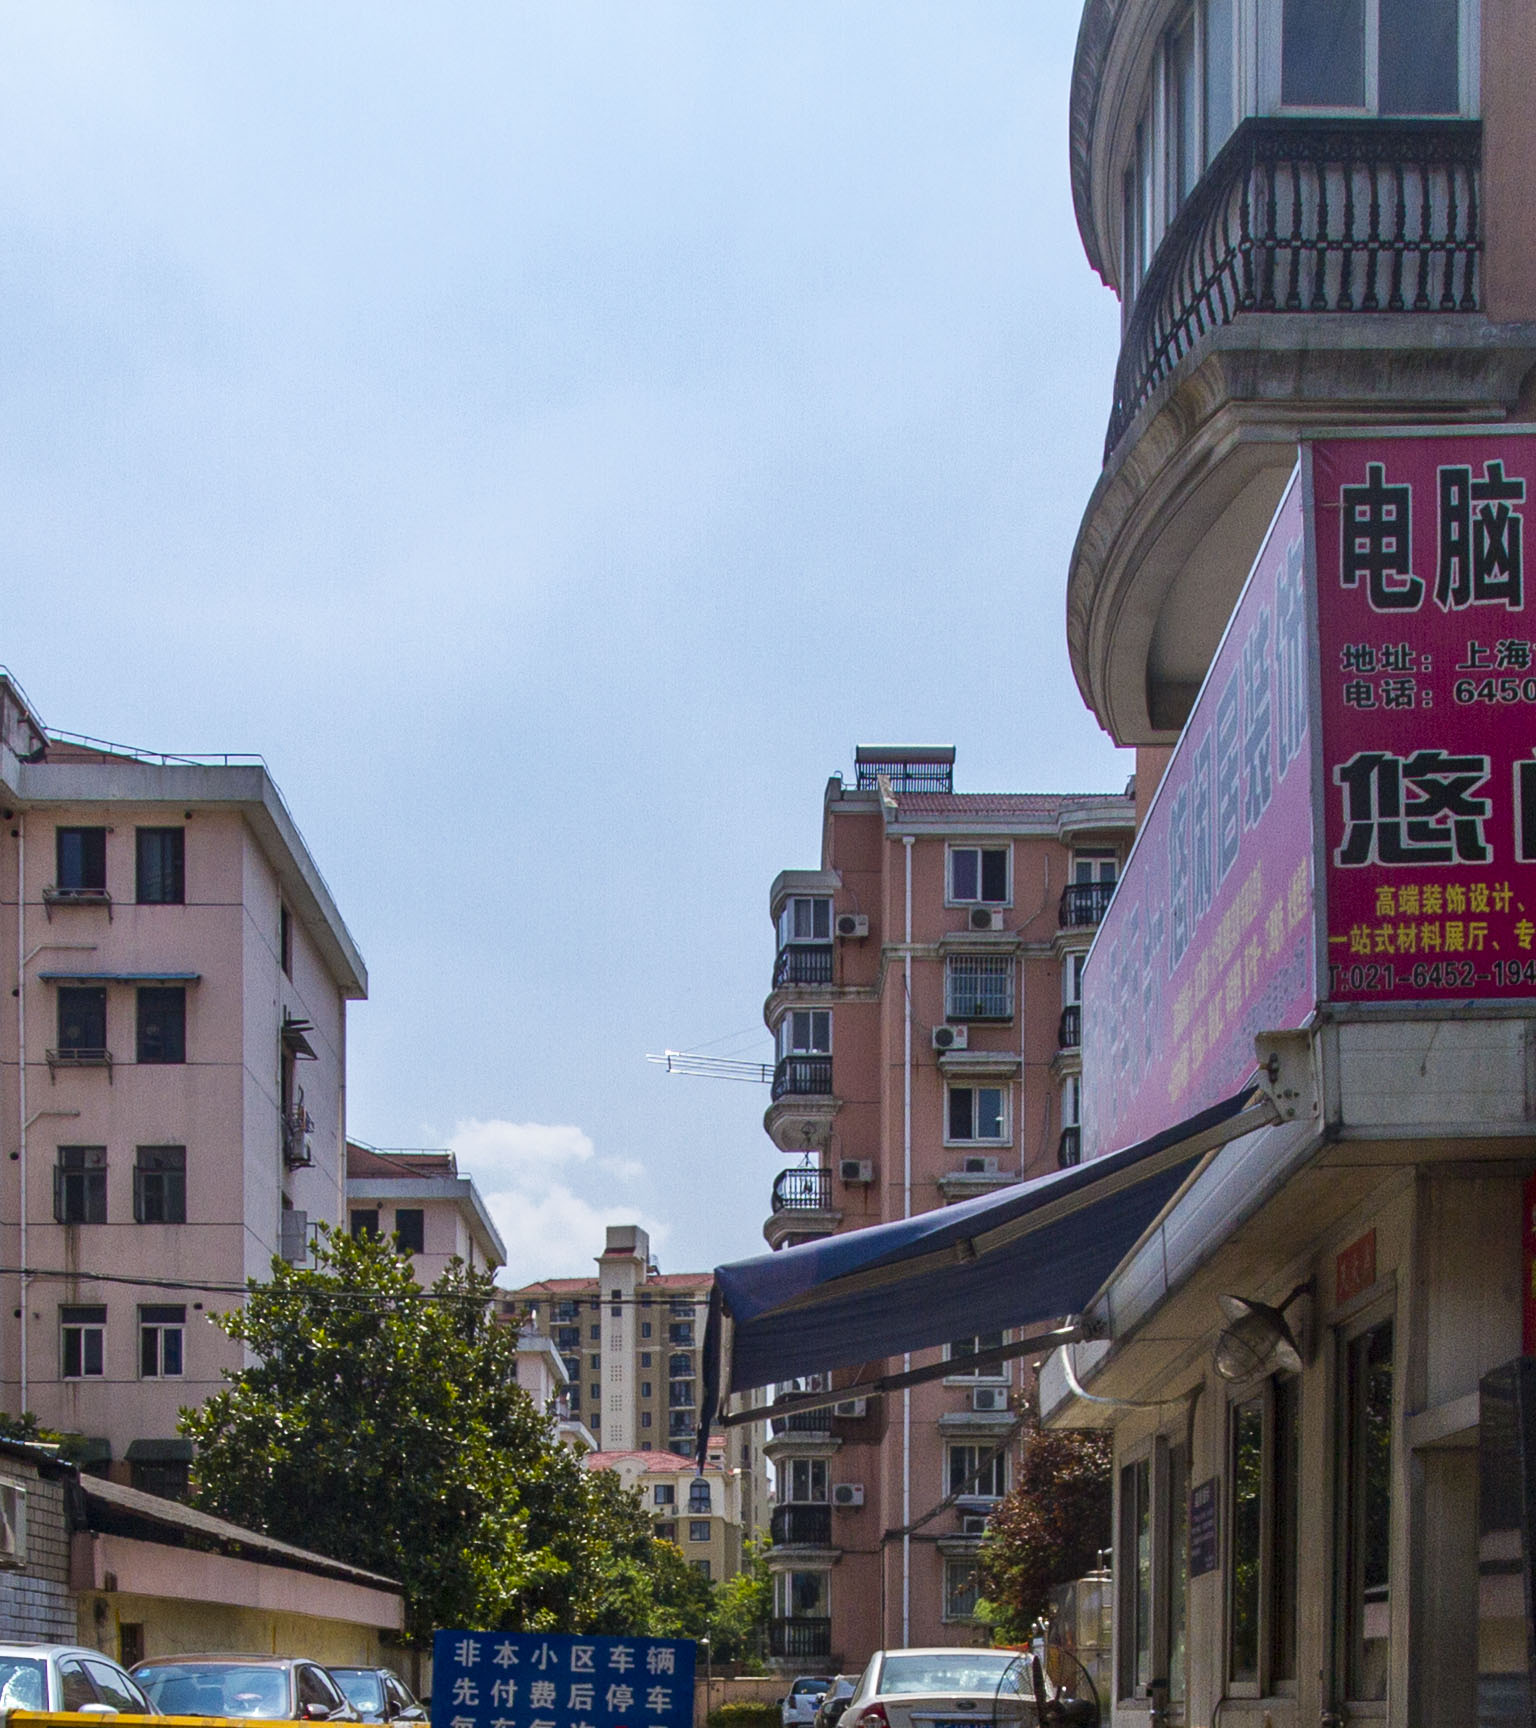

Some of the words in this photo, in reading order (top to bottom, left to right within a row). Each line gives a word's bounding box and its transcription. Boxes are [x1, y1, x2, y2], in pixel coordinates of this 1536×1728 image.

[1339, 459, 1526, 614] 电脑
[454, 1638, 676, 1676] 非本小区车辆
[451, 1676, 673, 1714] 先付费后停车
